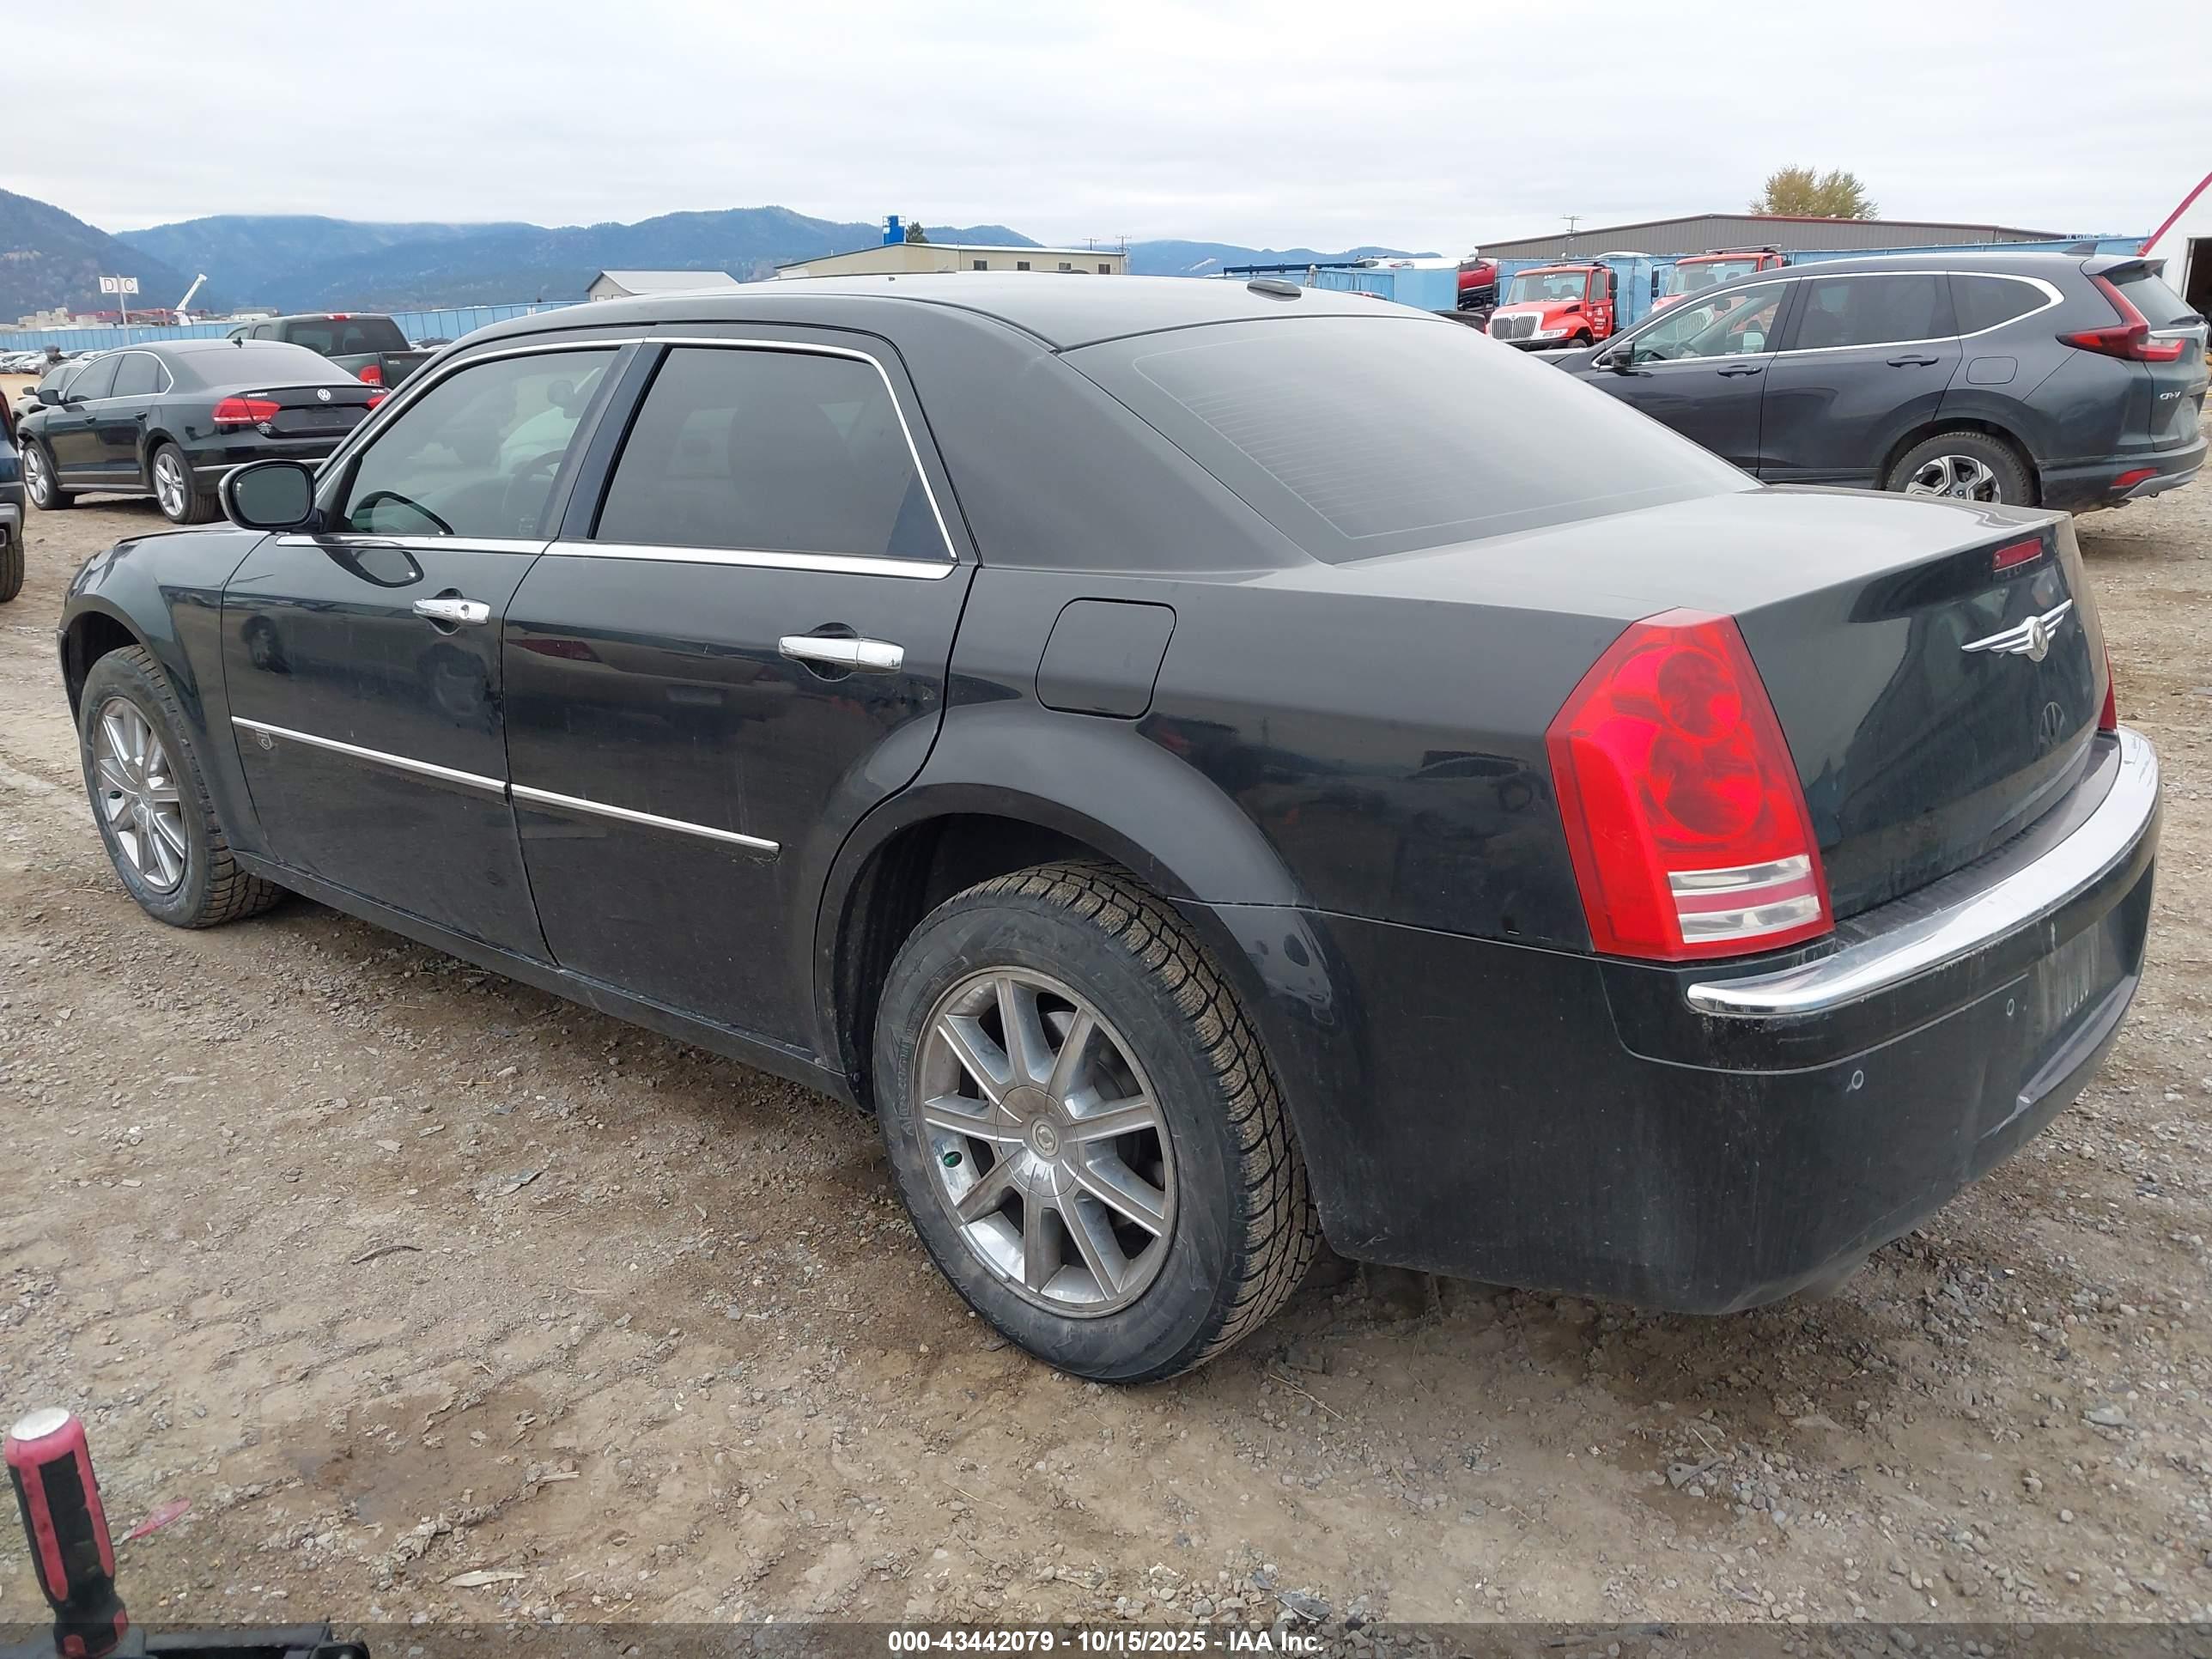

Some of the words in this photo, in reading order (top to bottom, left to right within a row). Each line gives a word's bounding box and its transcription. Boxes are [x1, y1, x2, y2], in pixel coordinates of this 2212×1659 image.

[103, 278, 114, 292] D
[124, 278, 134, 292] C
[2159, 391, 2181, 400] CR-V
